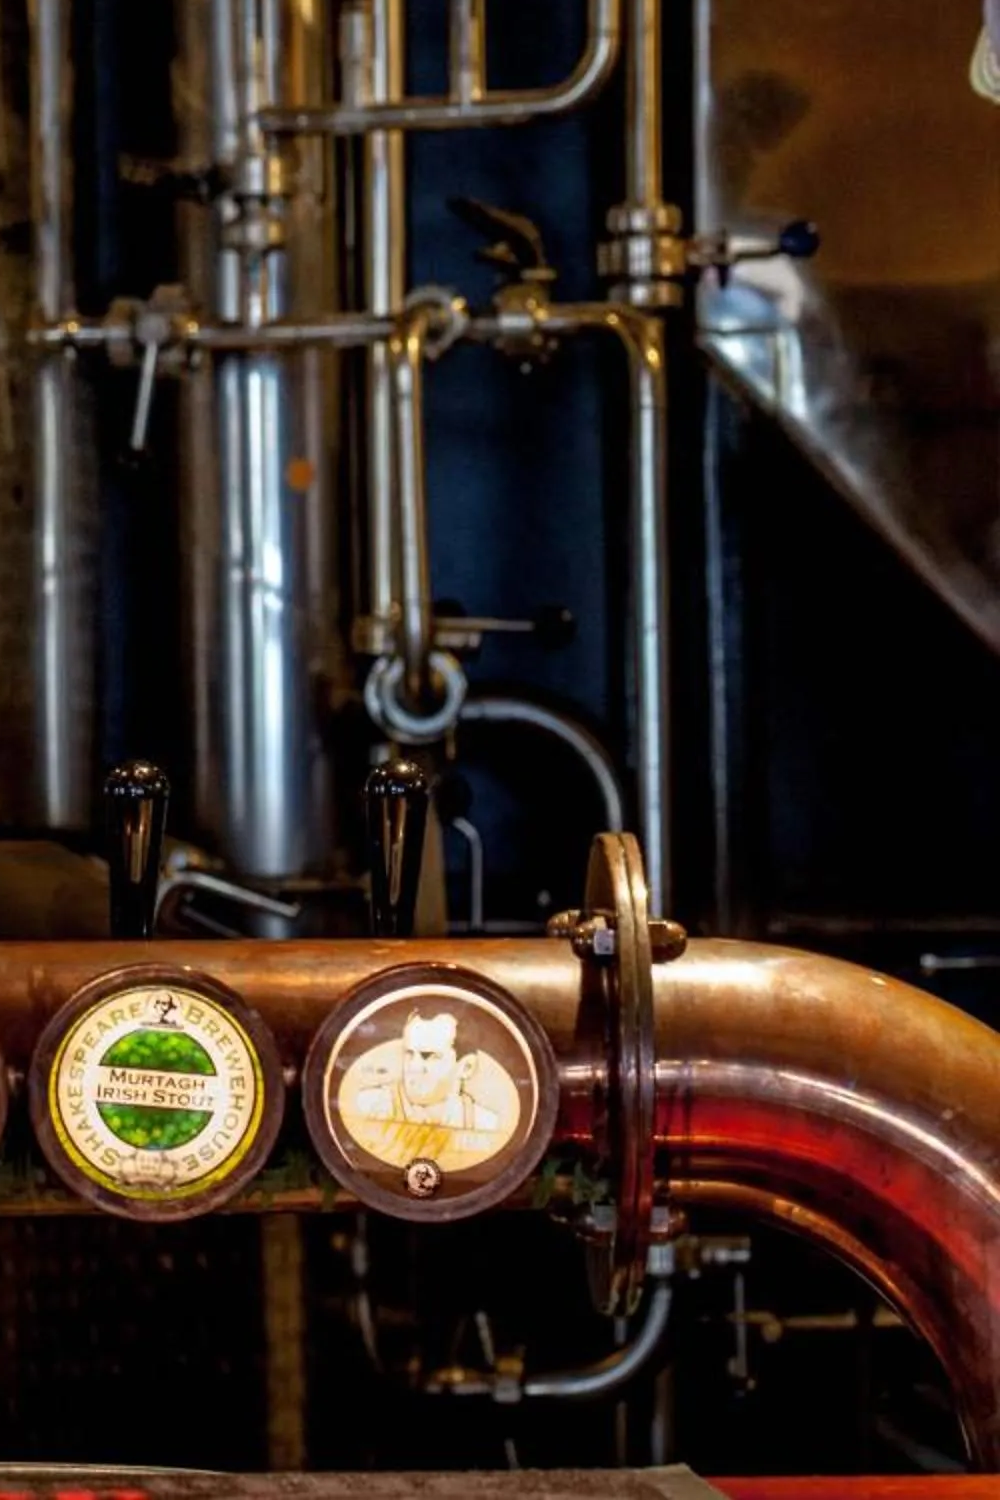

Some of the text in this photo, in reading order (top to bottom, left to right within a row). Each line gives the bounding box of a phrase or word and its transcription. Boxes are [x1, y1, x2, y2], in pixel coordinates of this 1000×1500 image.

[67, 1002, 142, 1167] SHAKESPEARE
[109, 1069, 205, 1090] MURTAGH
[97, 1084, 214, 1108] IRISH STOUT
